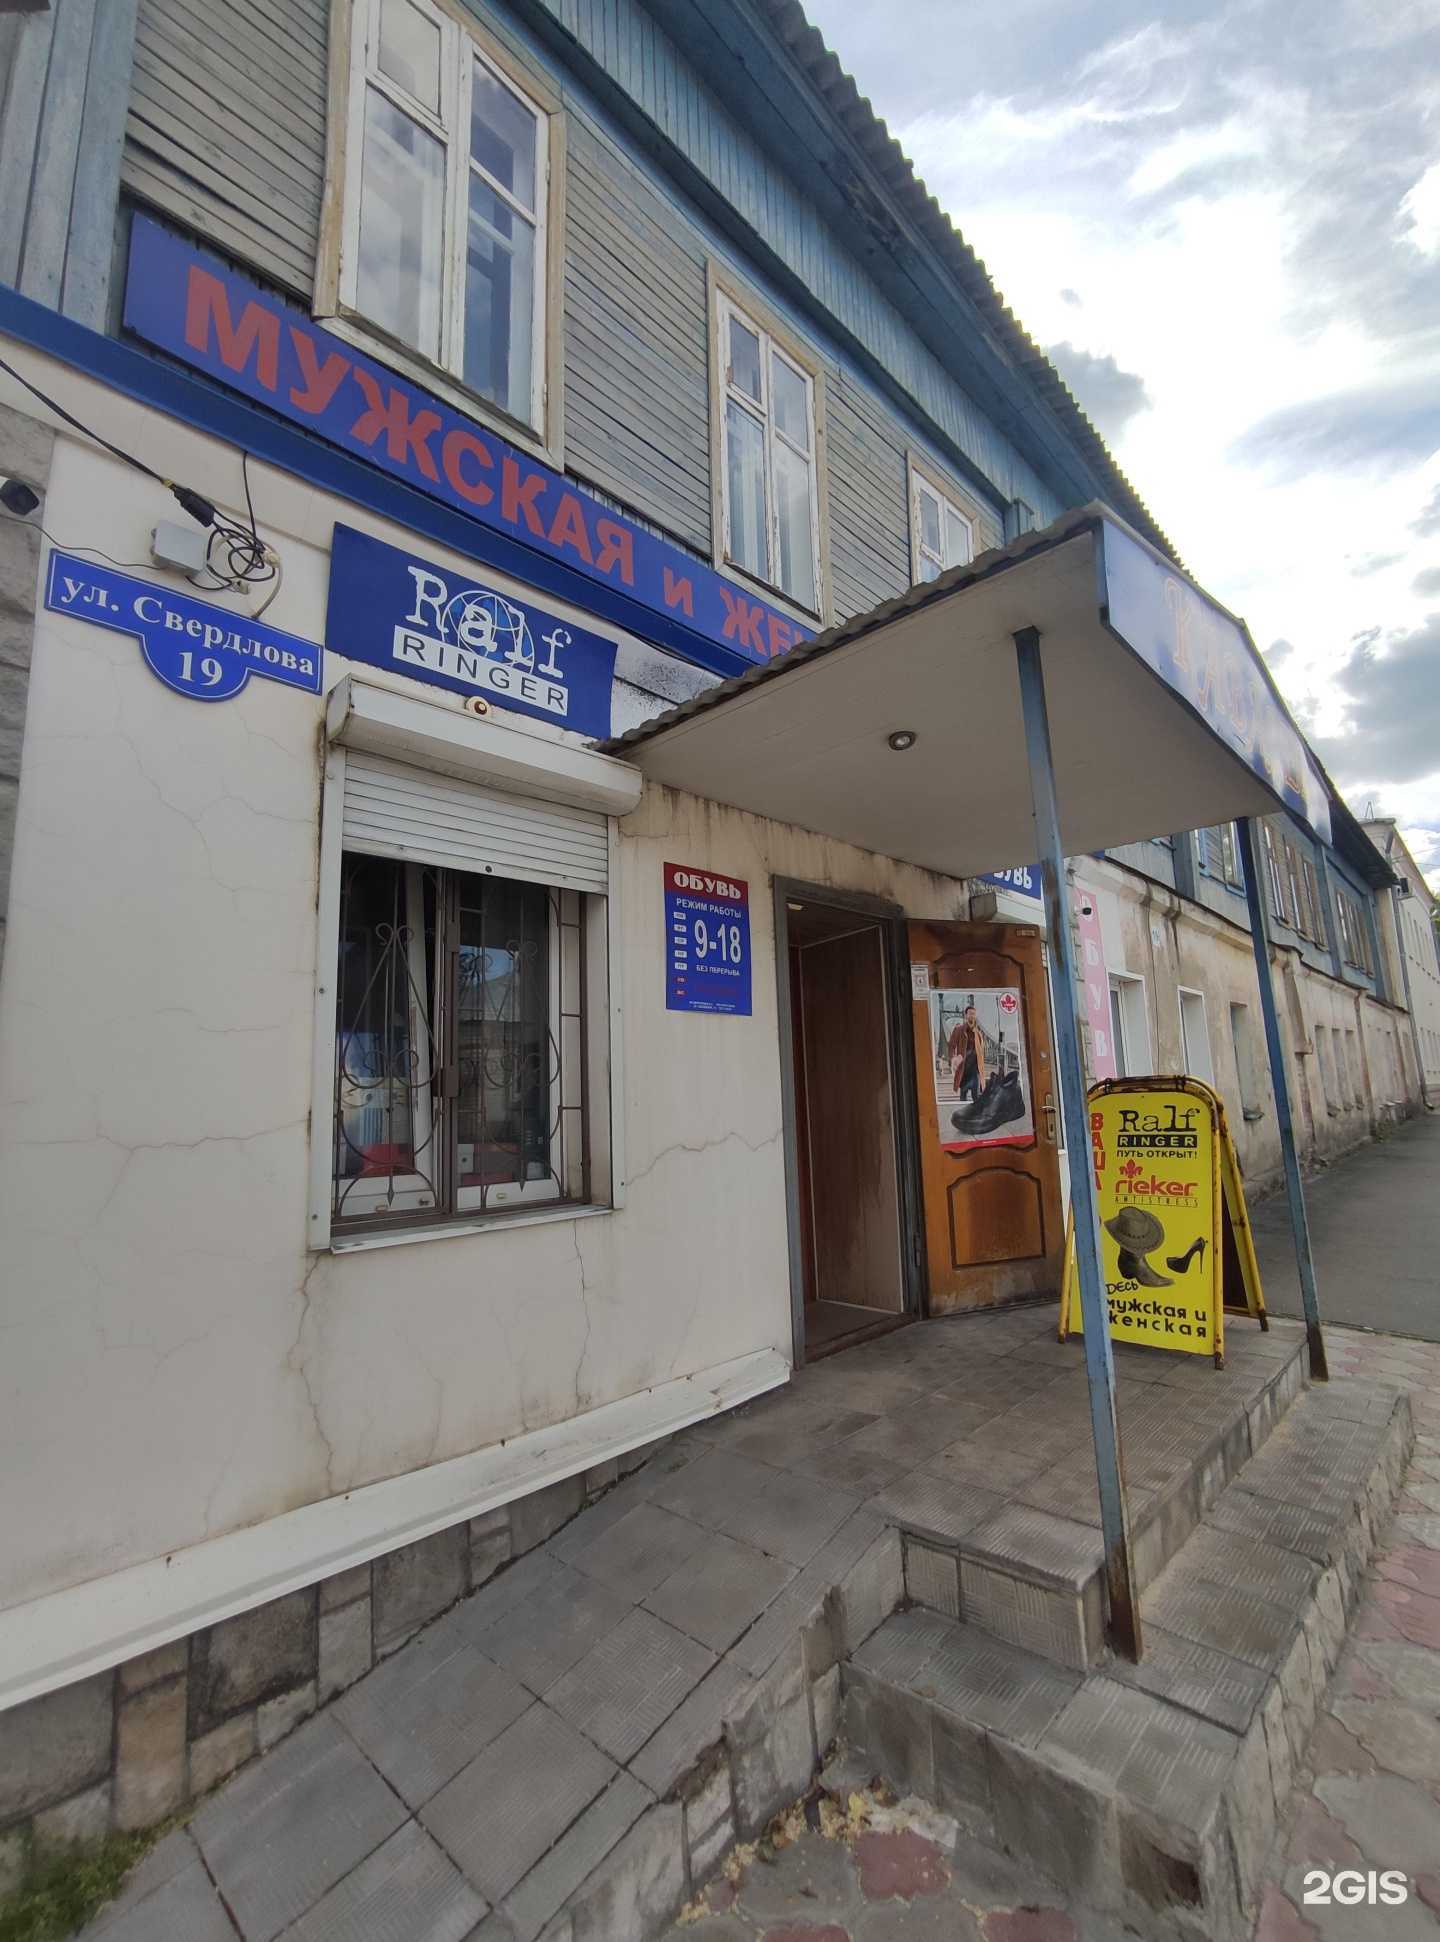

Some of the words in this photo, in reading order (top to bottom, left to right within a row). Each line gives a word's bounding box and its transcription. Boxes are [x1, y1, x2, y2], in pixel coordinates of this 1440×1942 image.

[184, 264, 637, 587] МУЖСКАЯ
[663, 566, 694, 618] и
[61, 576, 120, 613] ул.
[133, 595, 315, 677] Свердлова
[405, 565, 572, 679] Ralf
[178, 651, 223, 687] 19
[402, 633, 566, 711] RINGER
[673, 871, 742, 899] ОБУВЬ
[993, 866, 1032, 890] УВЬ
[676, 897, 708, 912] РЕЖИМ
[709, 904, 742, 919] РАБОТЫ
[694, 919, 742, 964] 9-18
[696, 964, 708, 973] БЕЗ
[709, 966, 741, 977] ПЕРЕРЫВА
[1118, 1105, 1200, 1132] Ralf
[1116, 1149, 1144, 1158] ПУТЬ
[1146, 1150, 1198, 1159] ОТКРЫТ!
[1118, 1135, 1196, 1147] RINGER
[1115, 1175, 1199, 1196] rieker
